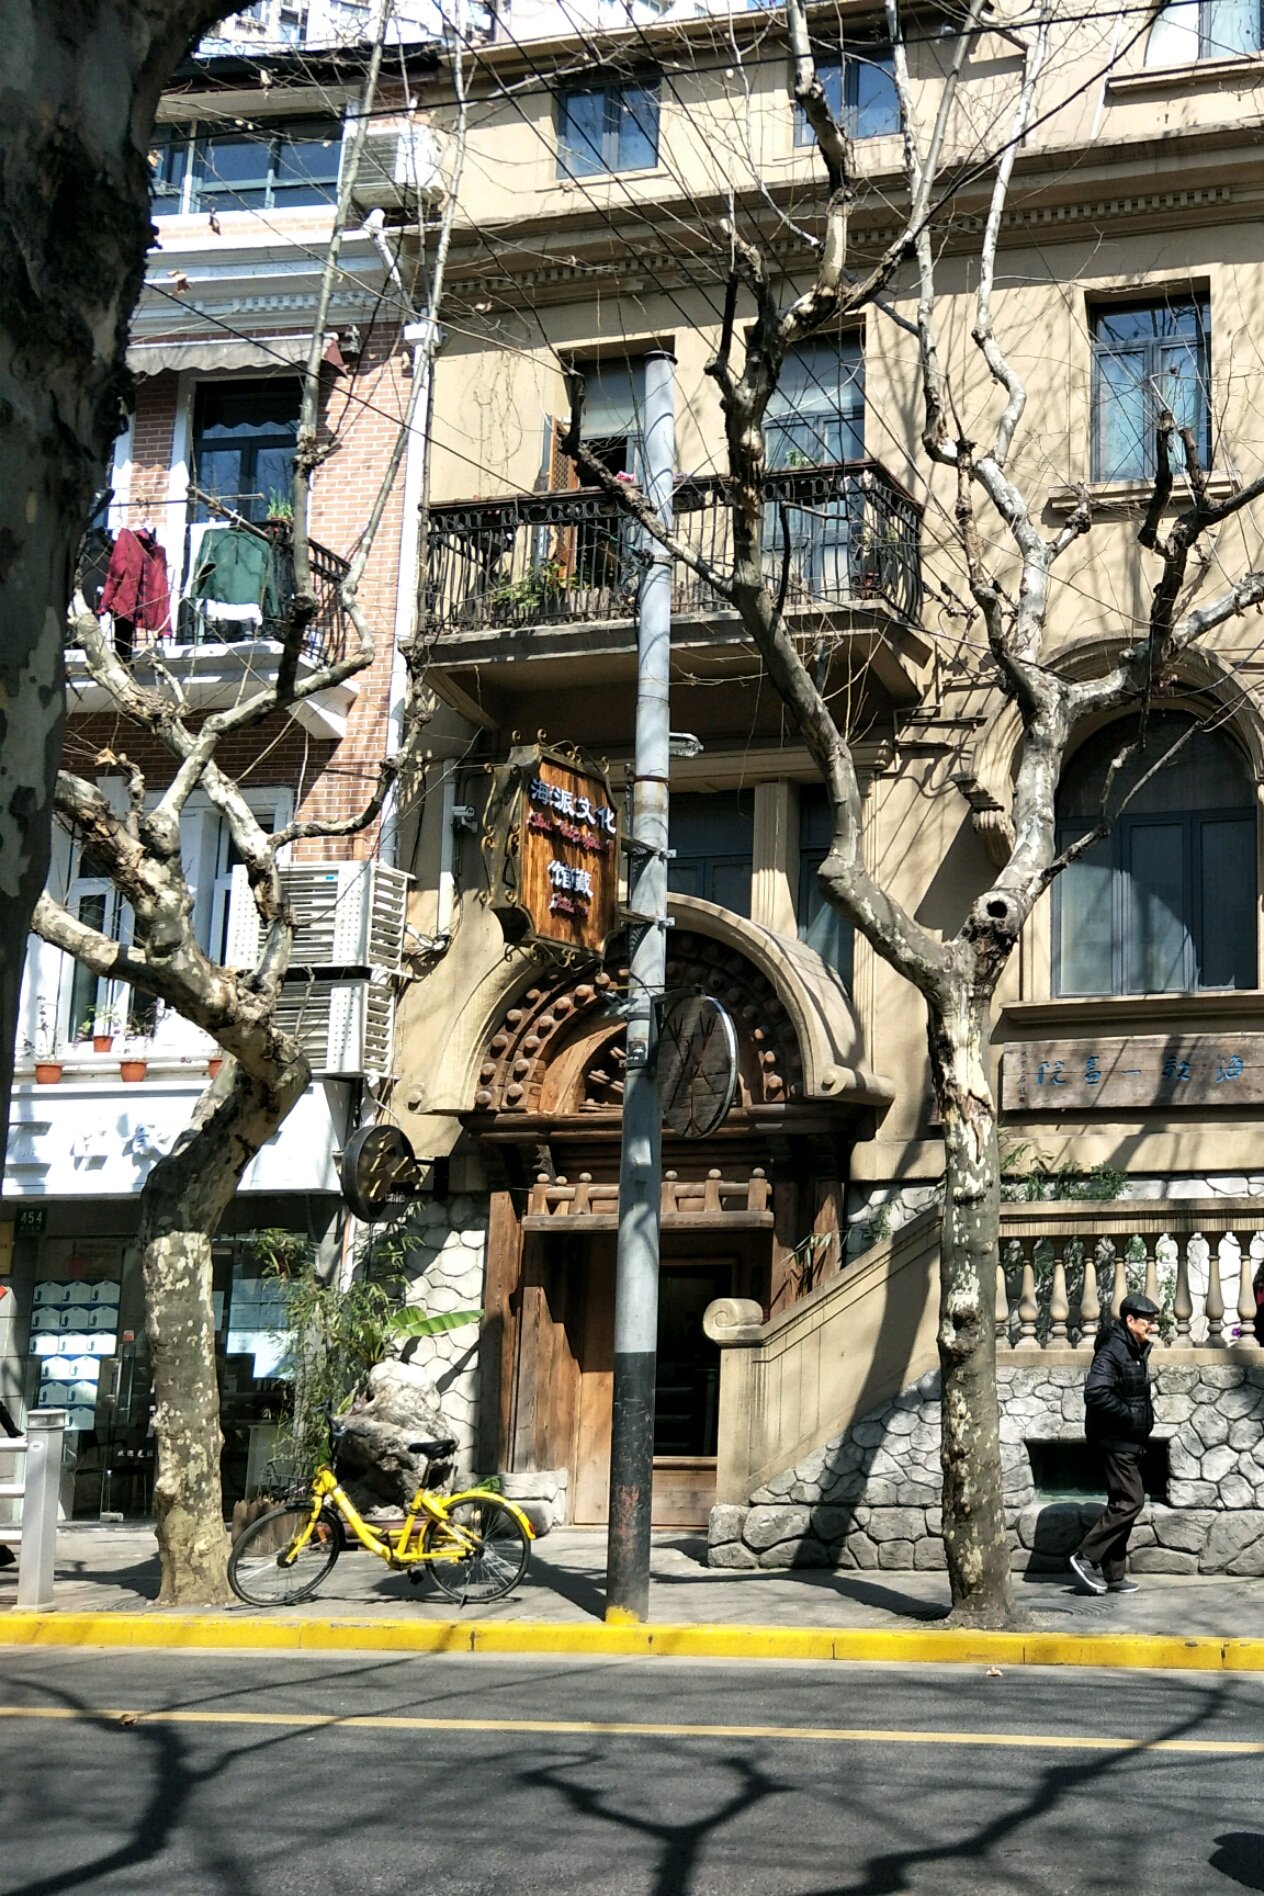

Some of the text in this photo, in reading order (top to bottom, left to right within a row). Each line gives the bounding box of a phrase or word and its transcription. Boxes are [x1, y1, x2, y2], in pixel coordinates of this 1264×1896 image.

[530, 778, 617, 834] 海派文化
[547, 859, 594, 898] 馆藏
[20, 1211, 43, 1225] 454
